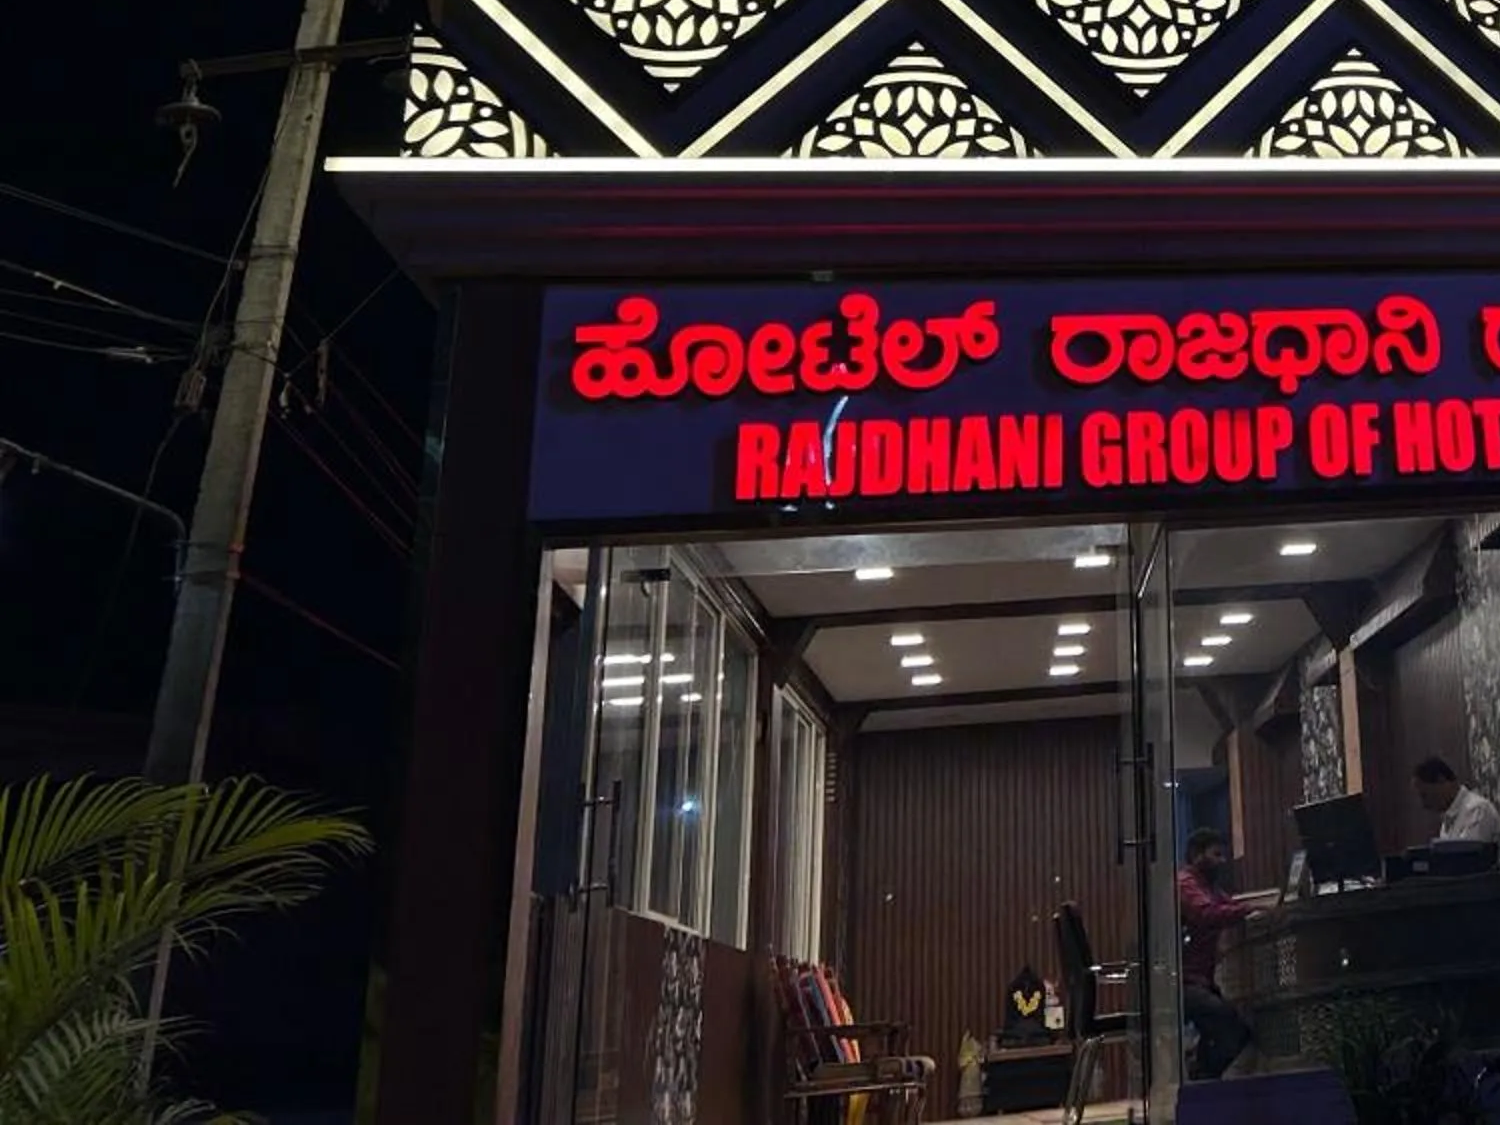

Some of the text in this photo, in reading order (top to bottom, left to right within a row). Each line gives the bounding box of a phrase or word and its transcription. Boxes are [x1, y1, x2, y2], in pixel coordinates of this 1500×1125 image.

[571, 293, 1000, 399] ಹೋಟೆಲ್
[1050, 294, 1441, 394] ರಾಜಧಾನಿ
[735, 414, 1063, 500] RAJDHANI
[1081, 406, 1293, 488] GROUP
[1308, 402, 1381, 478] OF
